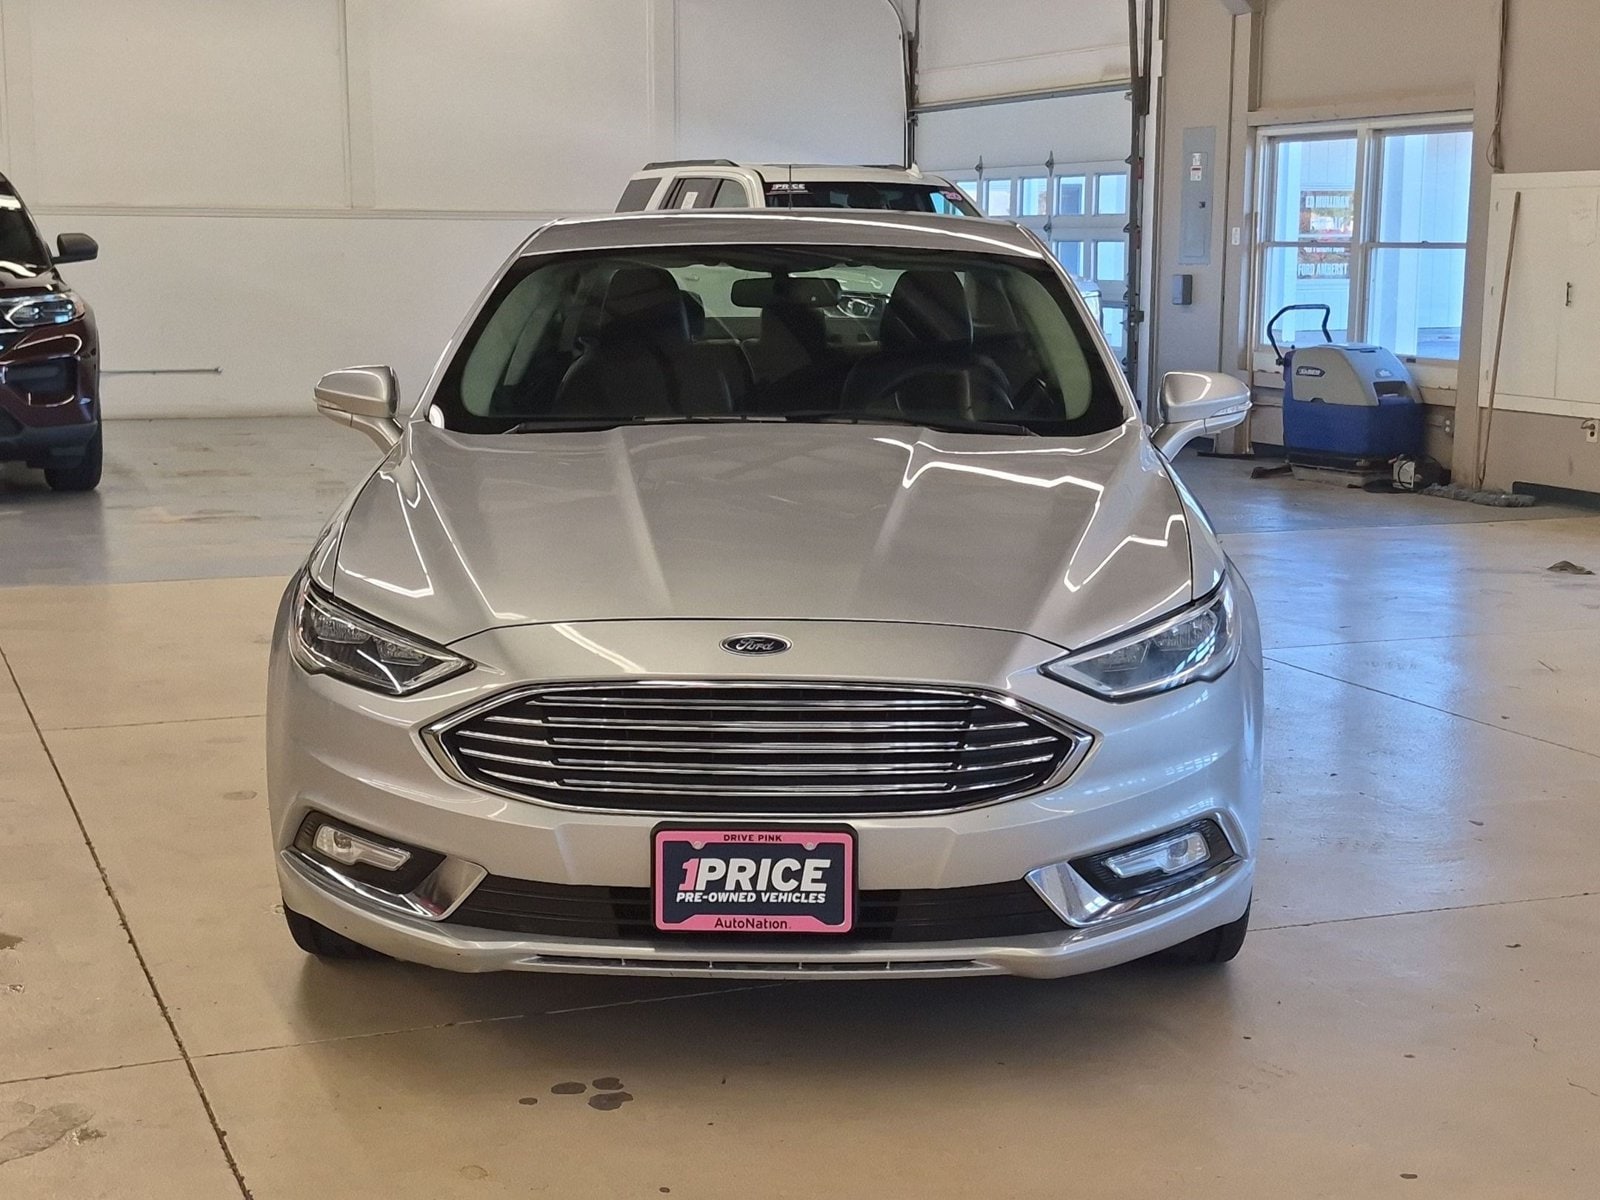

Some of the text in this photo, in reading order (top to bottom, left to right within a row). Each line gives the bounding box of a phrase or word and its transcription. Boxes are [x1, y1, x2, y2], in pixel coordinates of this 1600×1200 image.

[735, 638, 775, 650] Ford
[723, 834, 783, 842] DRIVE PINK
[676, 892, 826, 904] PRE-OWNED VEHICLES
[714, 917, 788, 930] AutoNation
